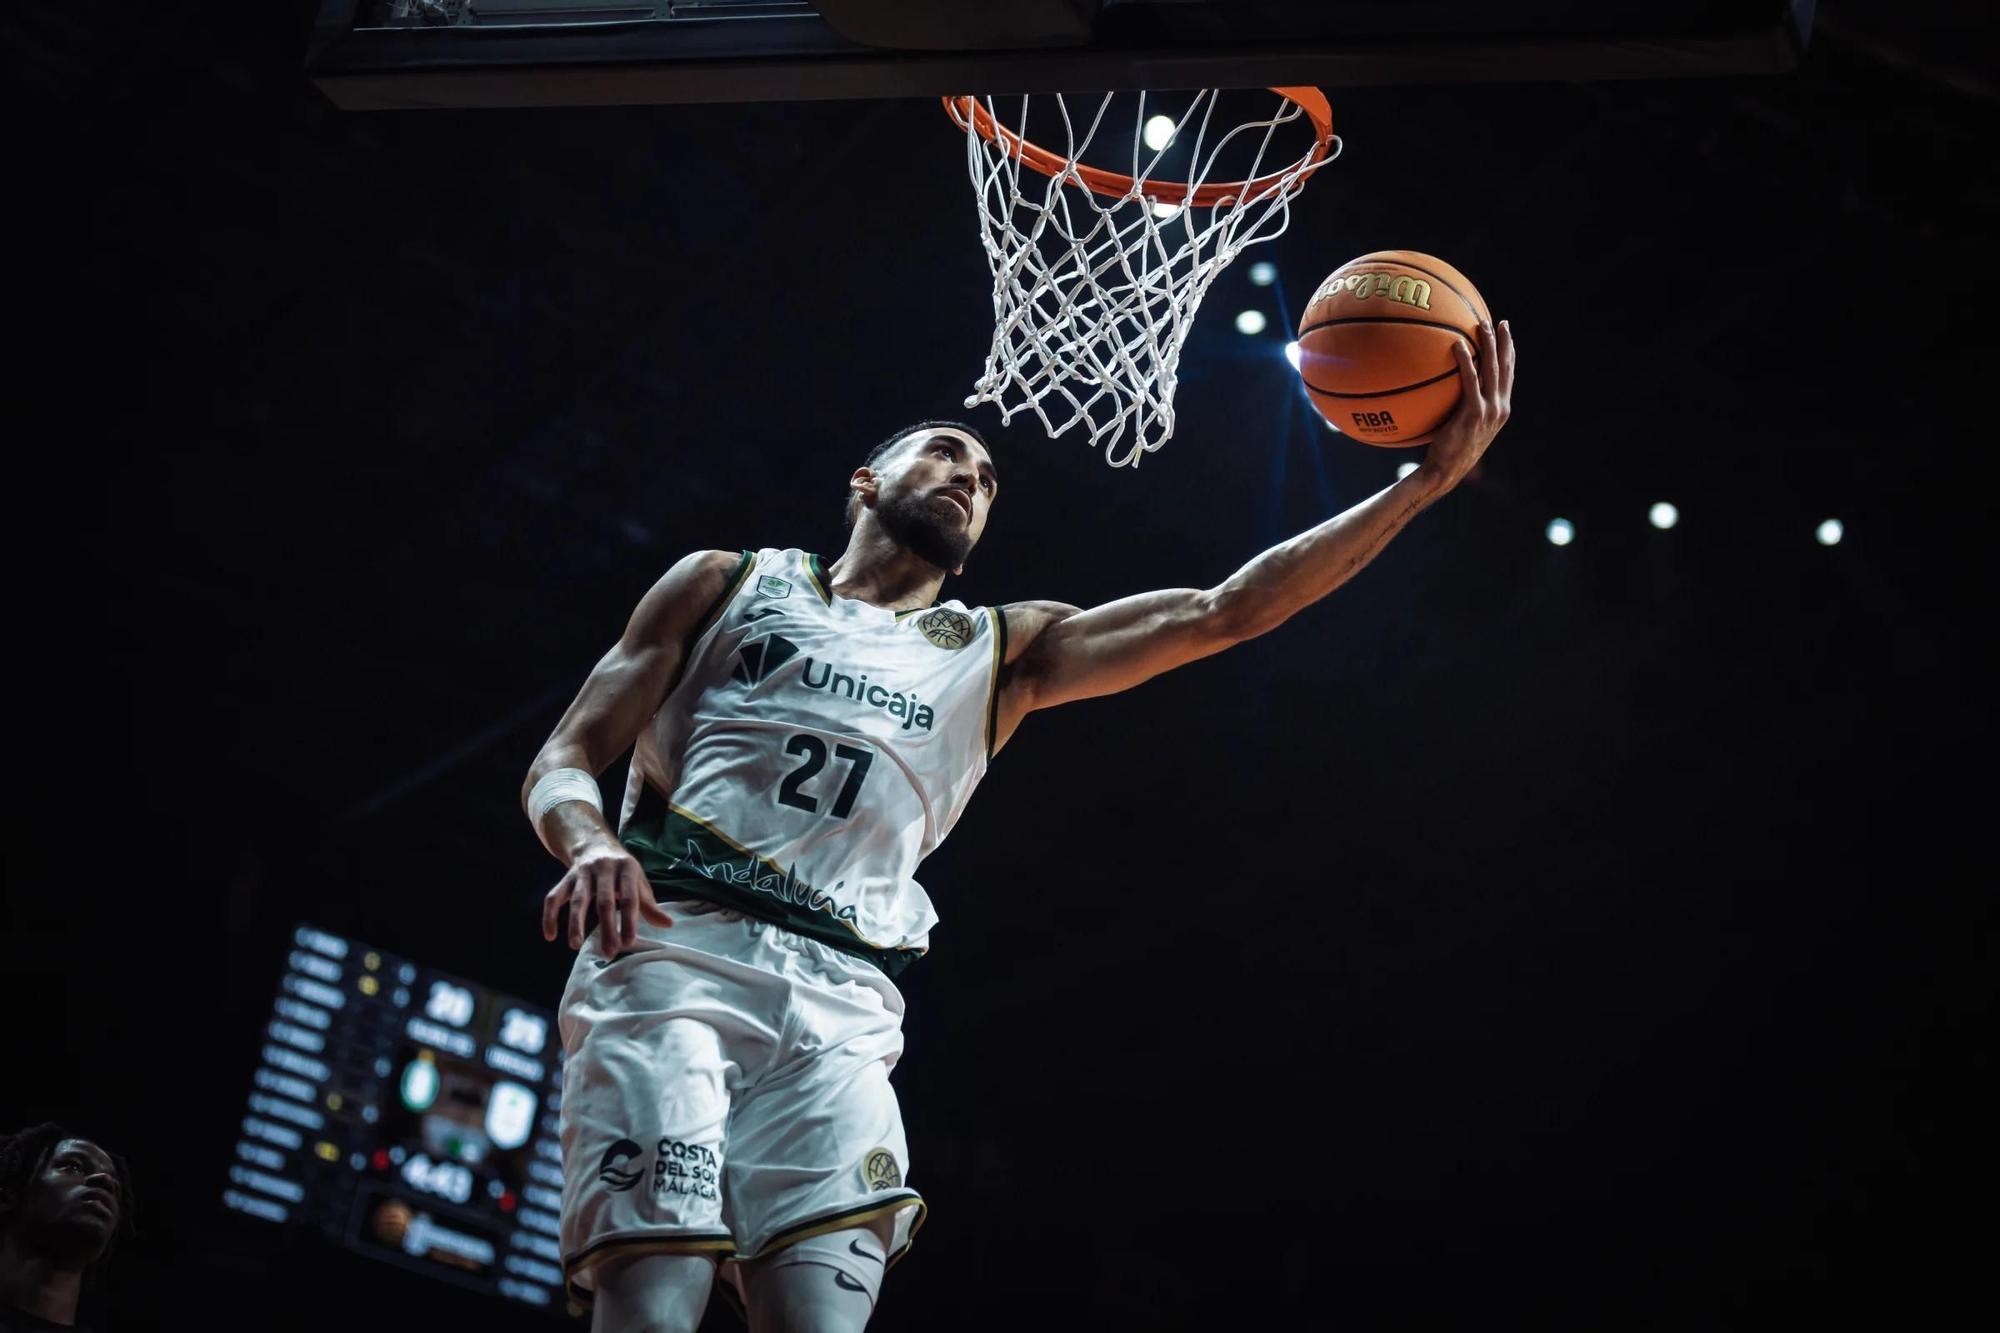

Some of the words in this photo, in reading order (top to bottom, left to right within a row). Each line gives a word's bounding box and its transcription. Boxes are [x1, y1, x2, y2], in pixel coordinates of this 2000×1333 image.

[1351, 411, 1394, 427] FIBA
[802, 657, 935, 732] Unicaja
[779, 733, 874, 819] 27
[658, 1138, 717, 1169] COSTA
[655, 1160, 688, 1178] DEL
[653, 1177, 718, 1201] MÁLAGA
